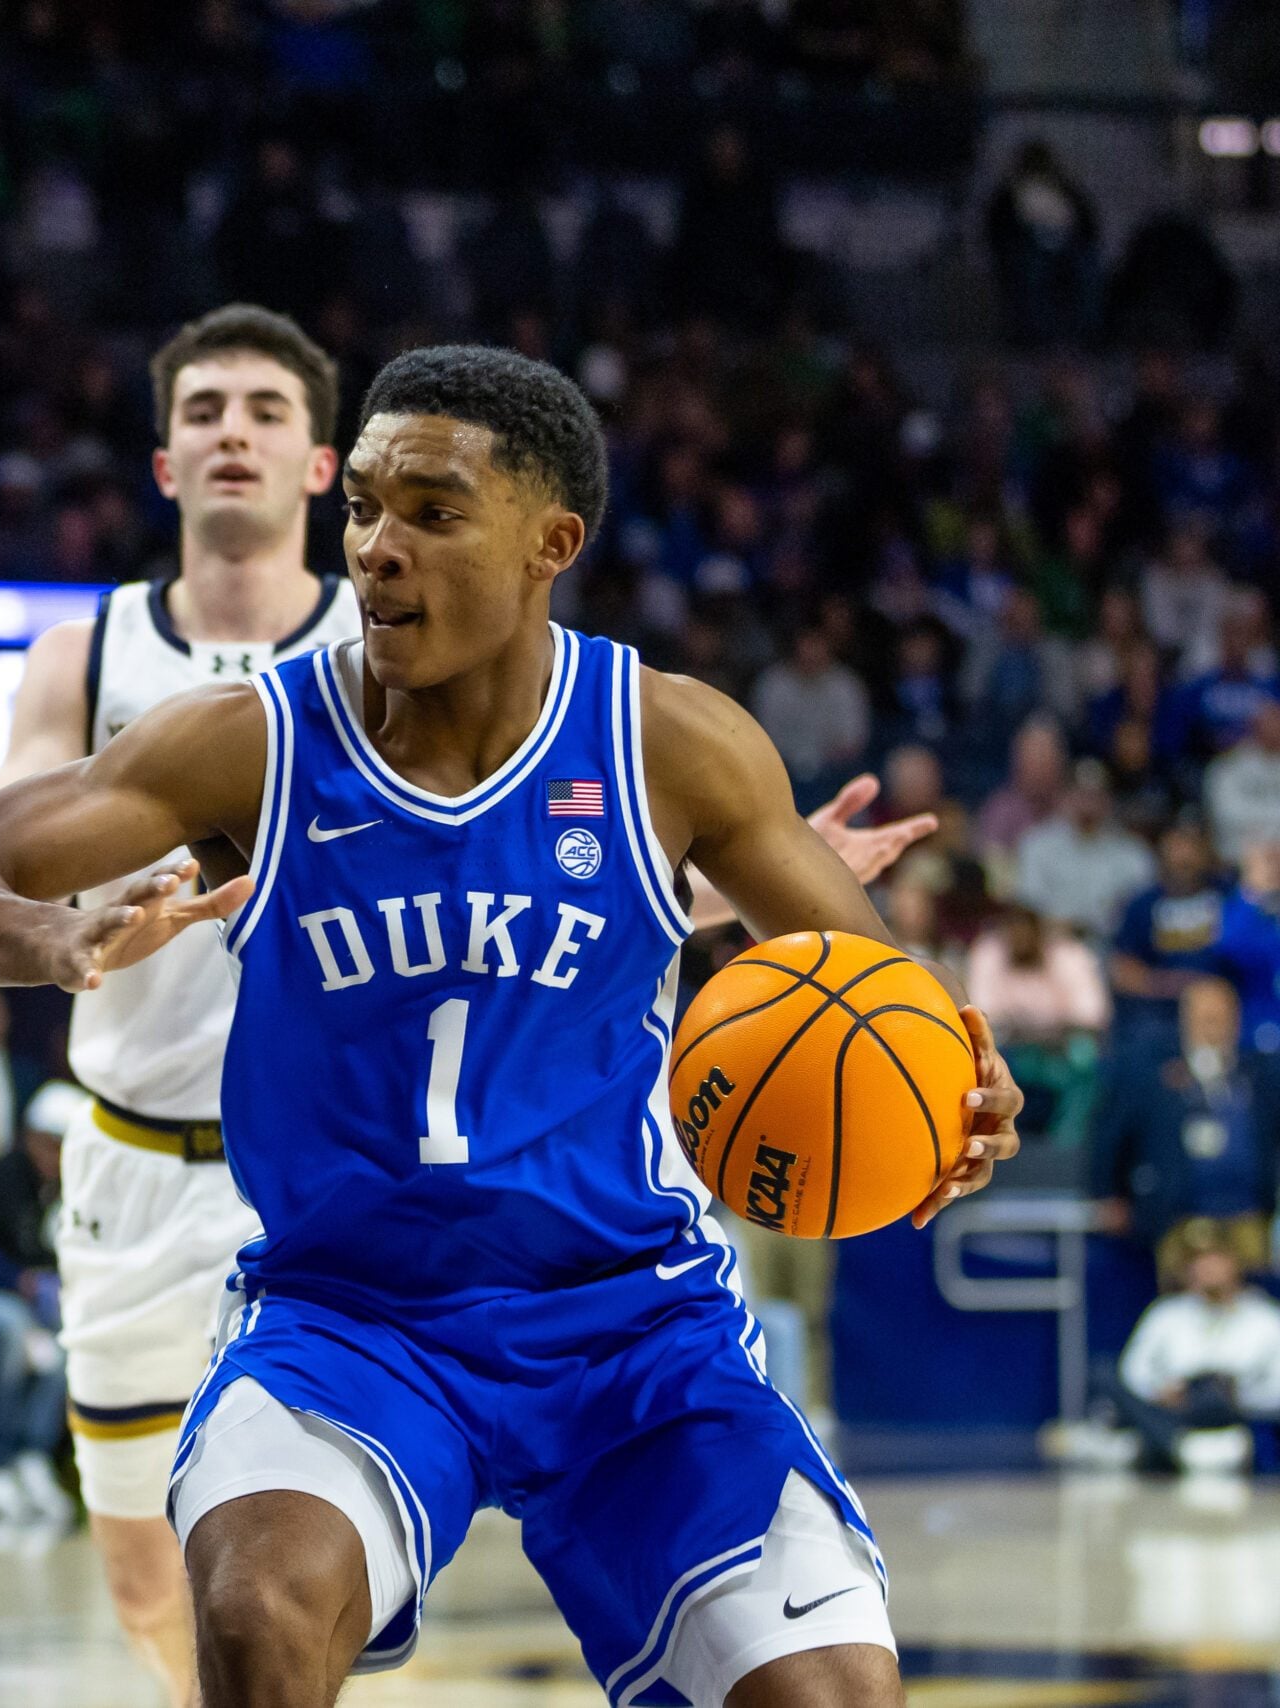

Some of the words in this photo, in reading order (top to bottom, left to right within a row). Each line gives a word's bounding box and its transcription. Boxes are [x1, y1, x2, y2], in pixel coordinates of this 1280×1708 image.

[563, 845, 598, 857] ACC
[298, 890, 607, 992] DUKE
[418, 998, 470, 1165] 1
[671, 1065, 737, 1174] lson
[746, 1143, 798, 1234] NCAA
